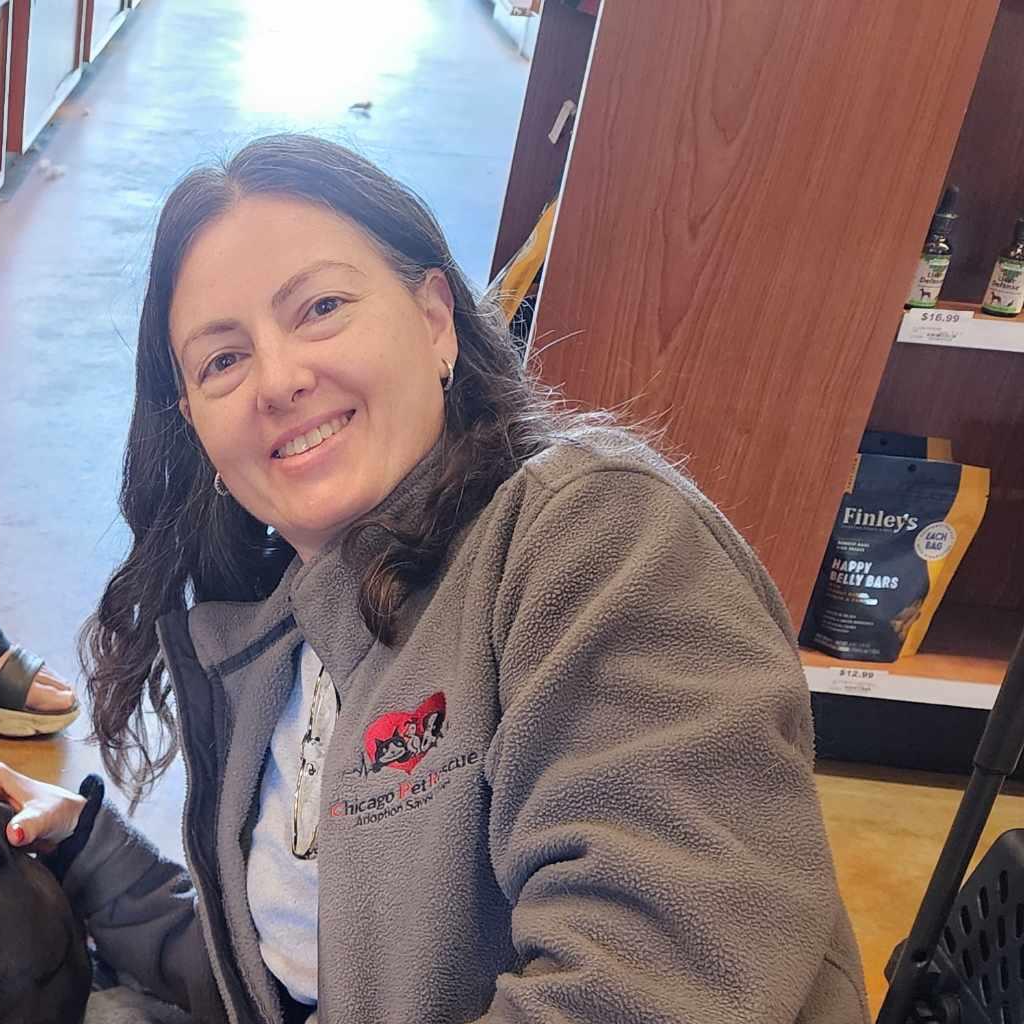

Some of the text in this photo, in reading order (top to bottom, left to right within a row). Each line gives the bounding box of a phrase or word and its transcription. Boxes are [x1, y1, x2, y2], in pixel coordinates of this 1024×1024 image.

[842, 507, 918, 533] Finley's
[832, 558, 873, 574] HAPPY
[829, 571, 900, 589] BELLY BARS
[330, 791, 395, 817] Chicago
[399, 779, 427, 800] Pet
